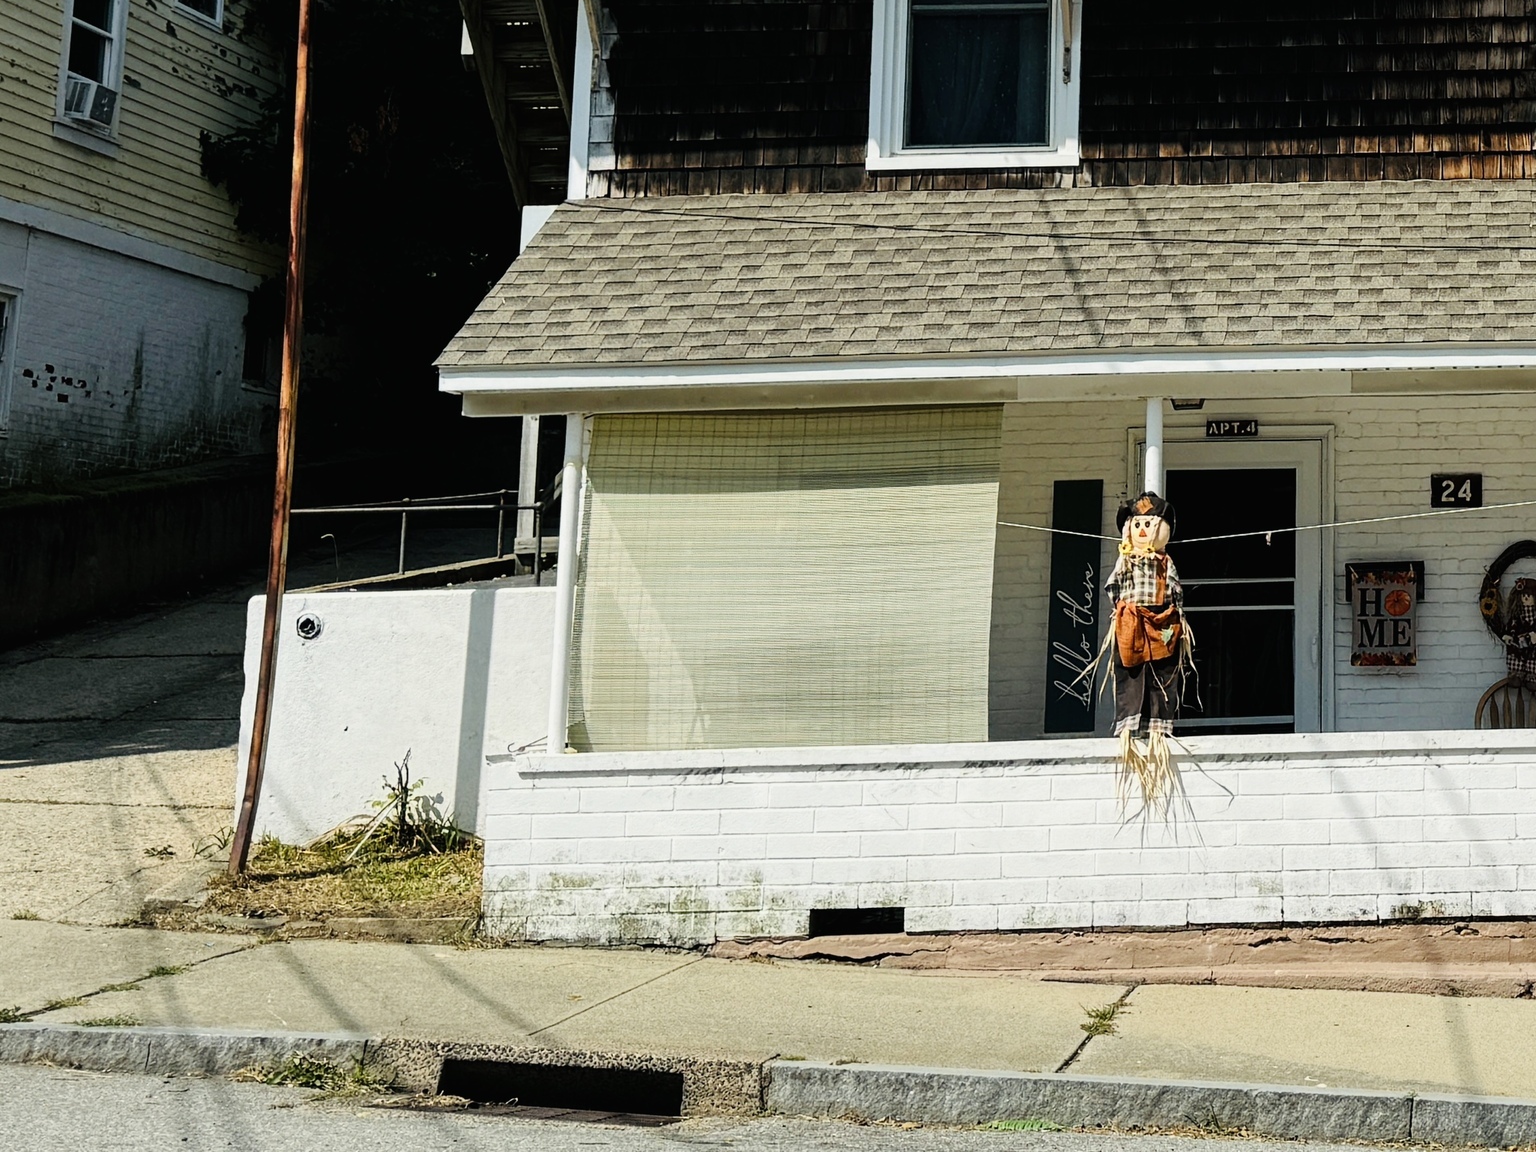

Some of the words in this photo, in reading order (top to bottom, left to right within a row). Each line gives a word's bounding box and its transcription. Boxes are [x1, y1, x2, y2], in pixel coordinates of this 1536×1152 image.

[1209, 421, 1256, 434] APT.4
[1441, 479, 1472, 502] 24
[1056, 562, 1095, 628] there
[1053, 633, 1093, 707] hello
